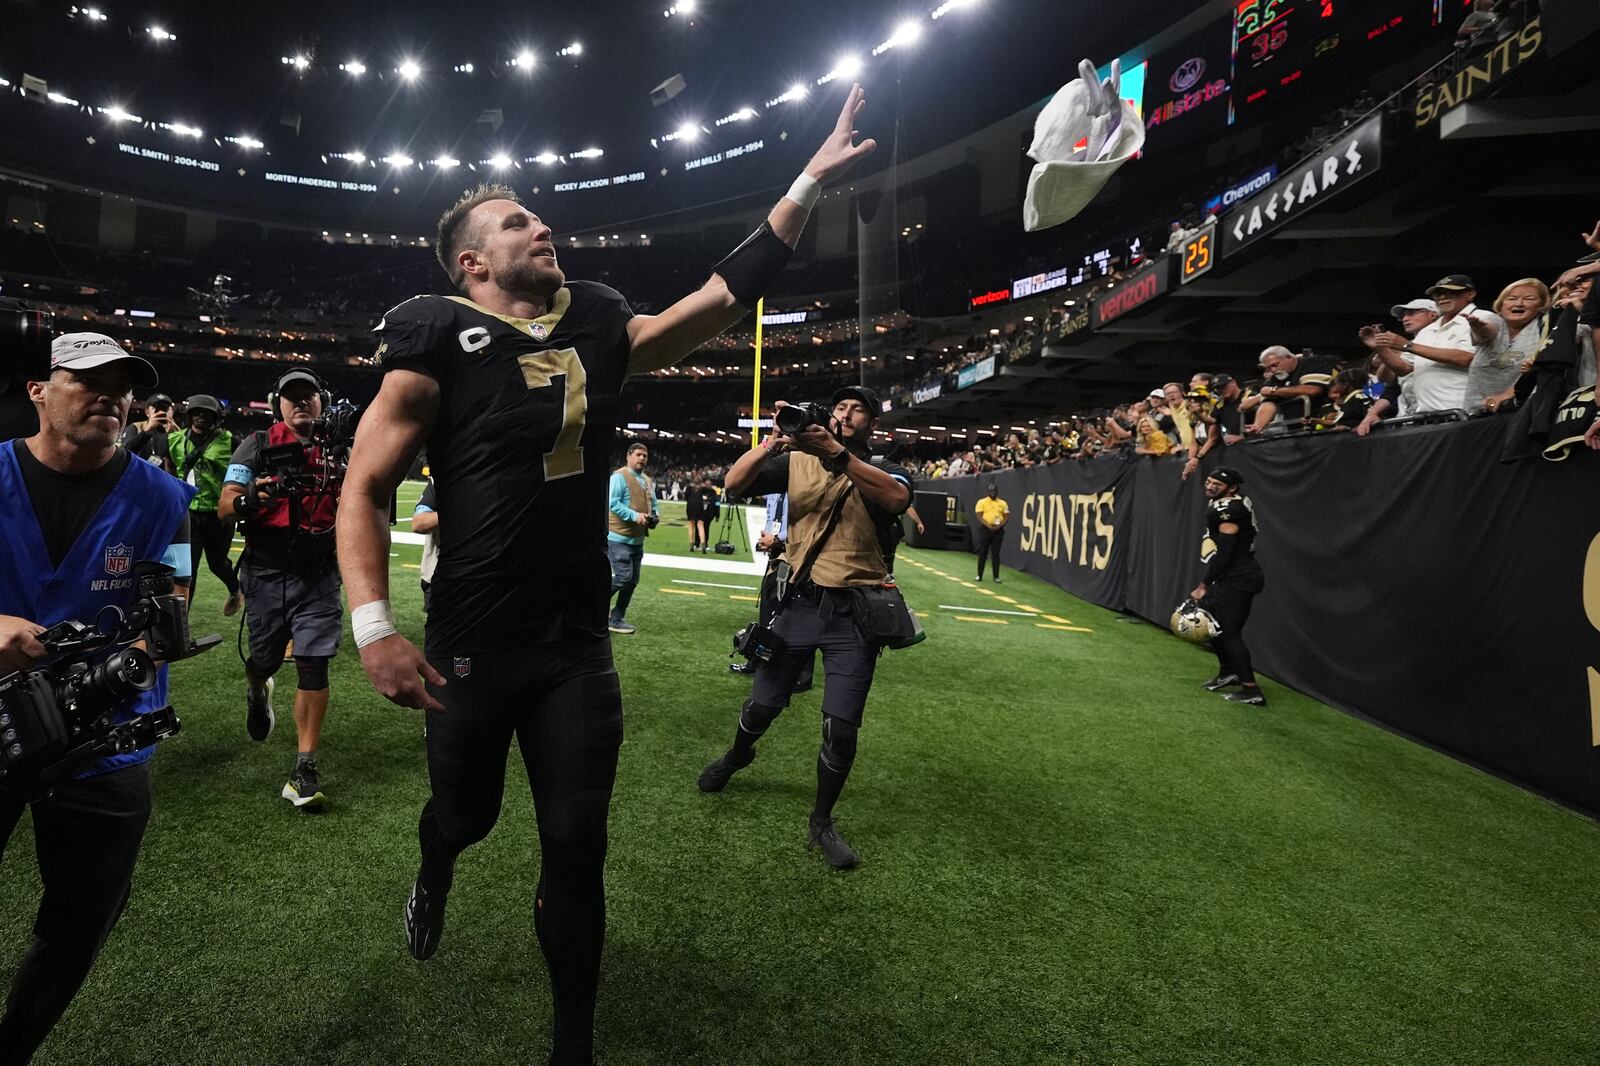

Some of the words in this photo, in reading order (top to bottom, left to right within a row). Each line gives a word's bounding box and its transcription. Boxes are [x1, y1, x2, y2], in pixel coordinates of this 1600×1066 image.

[1416, 15, 1542, 128] SAINTS
[1147, 79, 1226, 129] Allstate
[119, 143, 140, 155] WILL
[142, 148, 170, 162] SMITH
[174, 155, 219, 171] 2004-2013
[685, 159, 701, 171] SAM
[701, 153, 722, 167] MILLS
[726, 140, 764, 160] 1986-1994
[265, 172, 298, 184] MORTEN
[298, 176, 338, 189] ANDERSEN
[555, 182, 578, 192] RICKEY
[578, 178, 609, 190] JACKSON
[1222, 171, 1271, 206] Chevron
[1232, 139, 1362, 241] CAESARS
[1185, 235, 1209, 274] 25
[972, 289, 1009, 306] verizon
[1032, 276, 1067, 294] LEADERS
[1099, 273, 1157, 322] verizon
[458, 326, 491, 352] C
[1059, 314, 1088, 338] SAINTS
[517, 347, 588, 482] 7
[1020, 487, 1116, 570] SAINTS
[108, 557, 129, 571] NFL
[91, 580, 109, 591] NFL
[110, 579, 132, 590] FILMS
